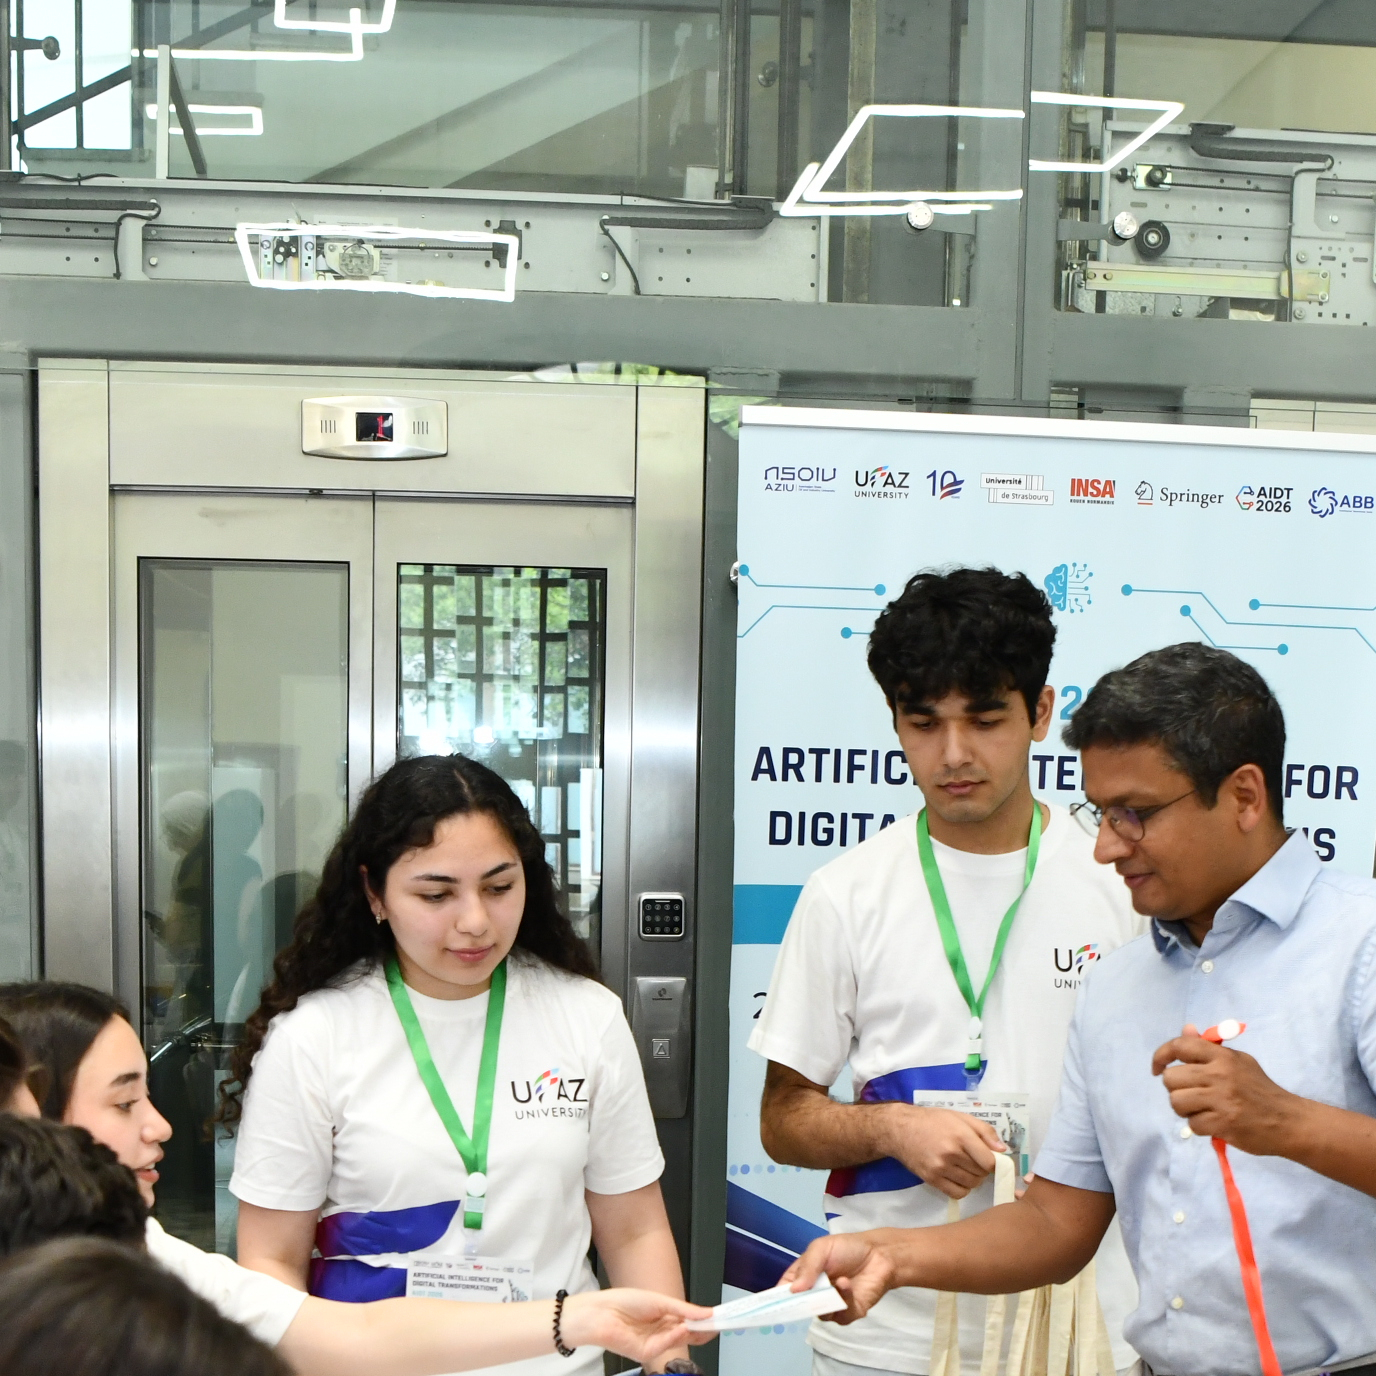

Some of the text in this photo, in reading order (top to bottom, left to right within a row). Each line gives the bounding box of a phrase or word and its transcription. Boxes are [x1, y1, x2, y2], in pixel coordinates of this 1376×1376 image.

[764, 483, 795, 492] AZIU
[985, 477, 1022, 486] Université
[1070, 478, 1115, 498] INSA
[854, 490, 909, 499] UNIVERSITY
[1011, 492, 1049, 502] Strasbourg
[1159, 487, 1224, 509] Springer
[1256, 486, 1294, 500] AIDT
[1256, 500, 1292, 513] 2026
[1339, 494, 1375, 510] ABB
[751, 746, 1359, 801] ARTIFIC FOR
[768, 810, 895, 847] DIGIT
